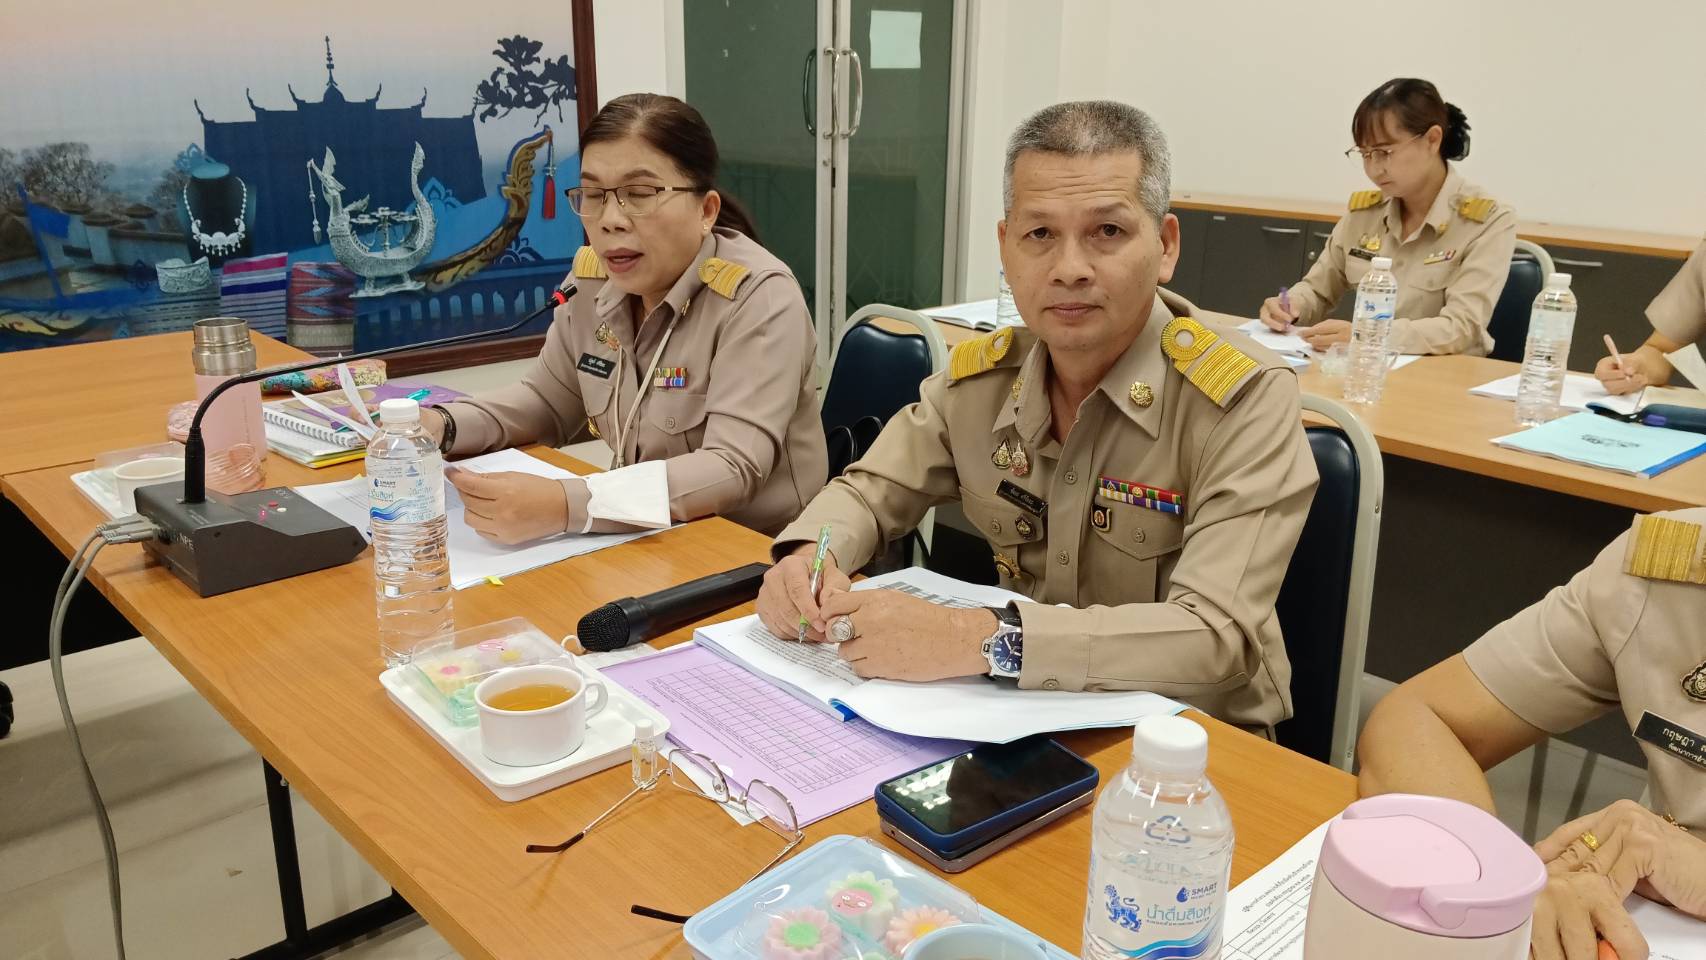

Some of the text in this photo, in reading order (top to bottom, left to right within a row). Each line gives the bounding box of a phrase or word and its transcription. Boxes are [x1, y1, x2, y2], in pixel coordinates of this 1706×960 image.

[1191, 882, 1218, 896] SMART
[1147, 902, 1213, 922] น้ำดื่มสิงห์
